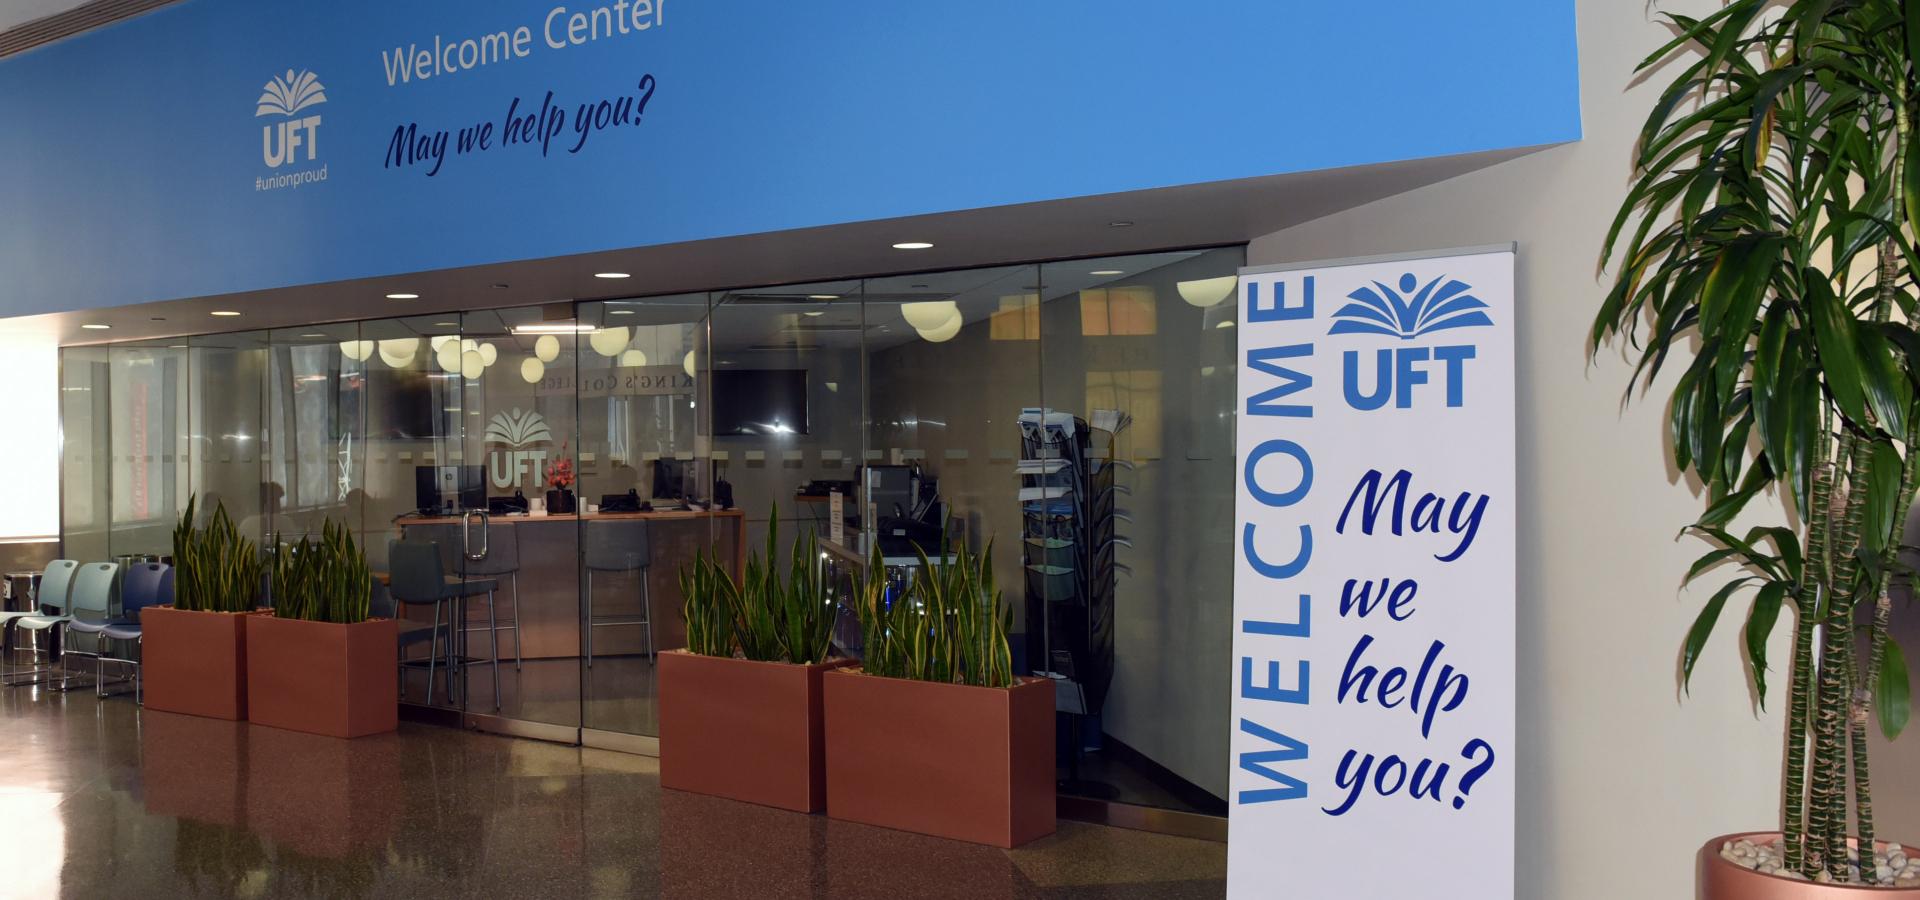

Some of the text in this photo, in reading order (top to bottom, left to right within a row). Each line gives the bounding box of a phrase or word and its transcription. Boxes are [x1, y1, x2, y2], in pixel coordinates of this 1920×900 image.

[382, 0, 665, 86] Welcome Center
[263, 115, 321, 168] UFT
[385, 73, 656, 177] May we help you?
[255, 162, 328, 192] #unionproud
[1343, 345, 1476, 411] UFT
[491, 450, 547, 489] UFT
[1238, 275, 1315, 805] WELCOME
[1335, 468, 1490, 562] May
[1339, 577, 1418, 622] we
[1337, 634, 1470, 740] help
[1321, 737, 1495, 817] you?
